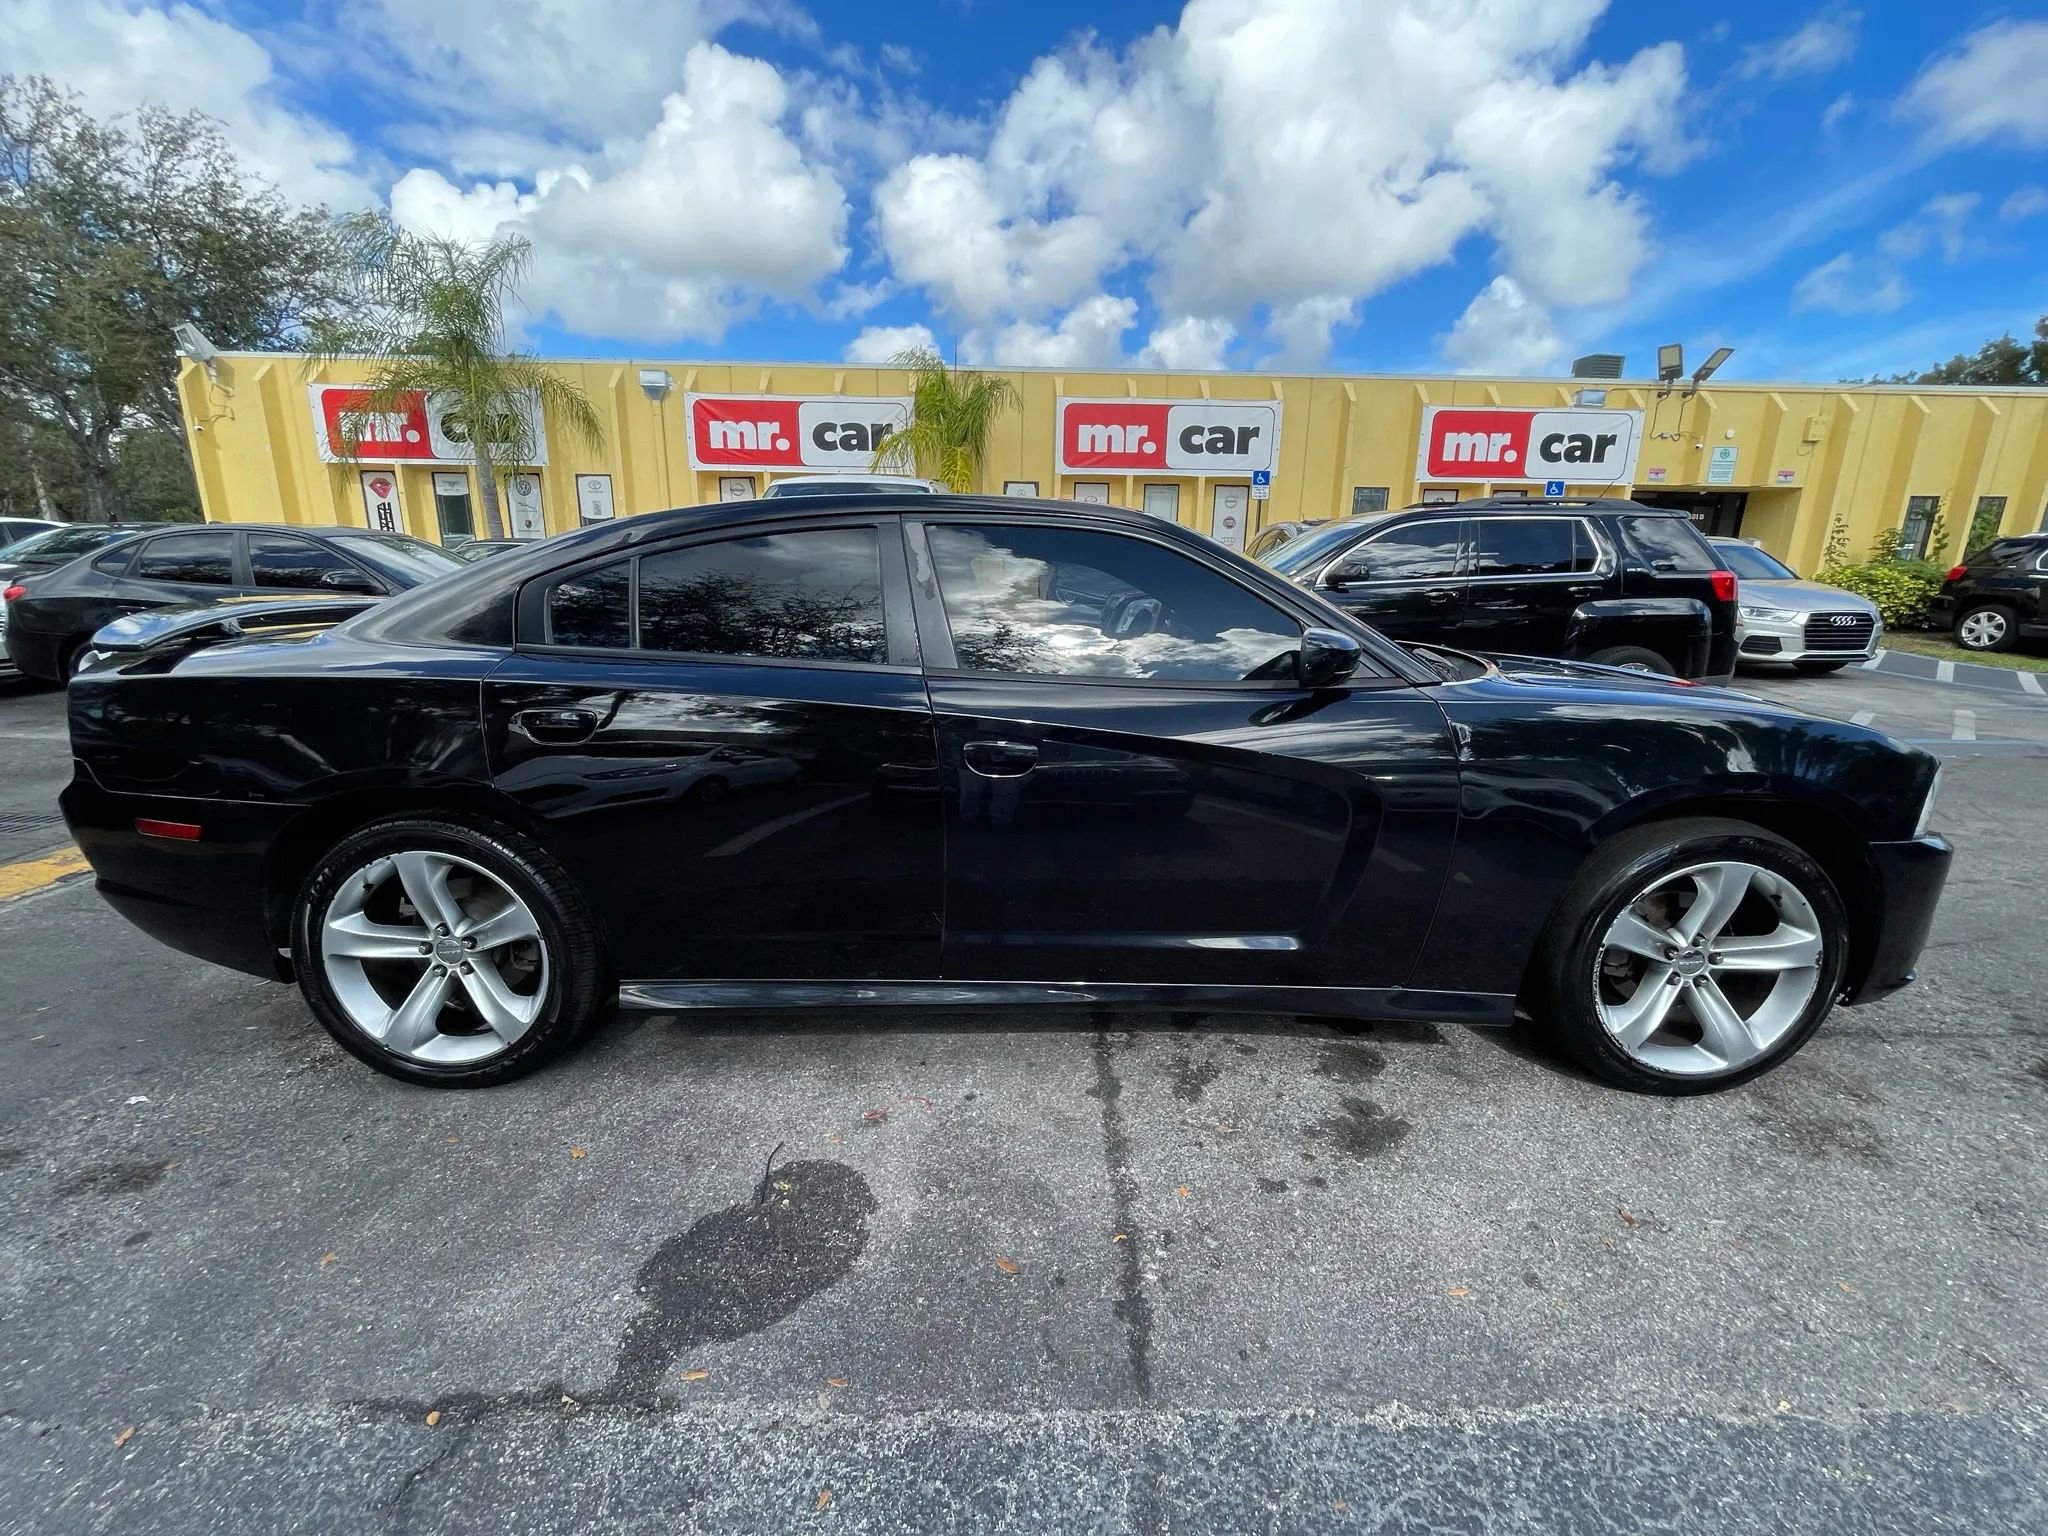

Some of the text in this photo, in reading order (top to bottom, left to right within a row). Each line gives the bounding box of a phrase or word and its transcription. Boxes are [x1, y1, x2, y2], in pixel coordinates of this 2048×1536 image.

[708, 420, 893, 452] mr. car
[1077, 423, 1260, 455] mr. car
[1442, 431, 1617, 464] mr. car
